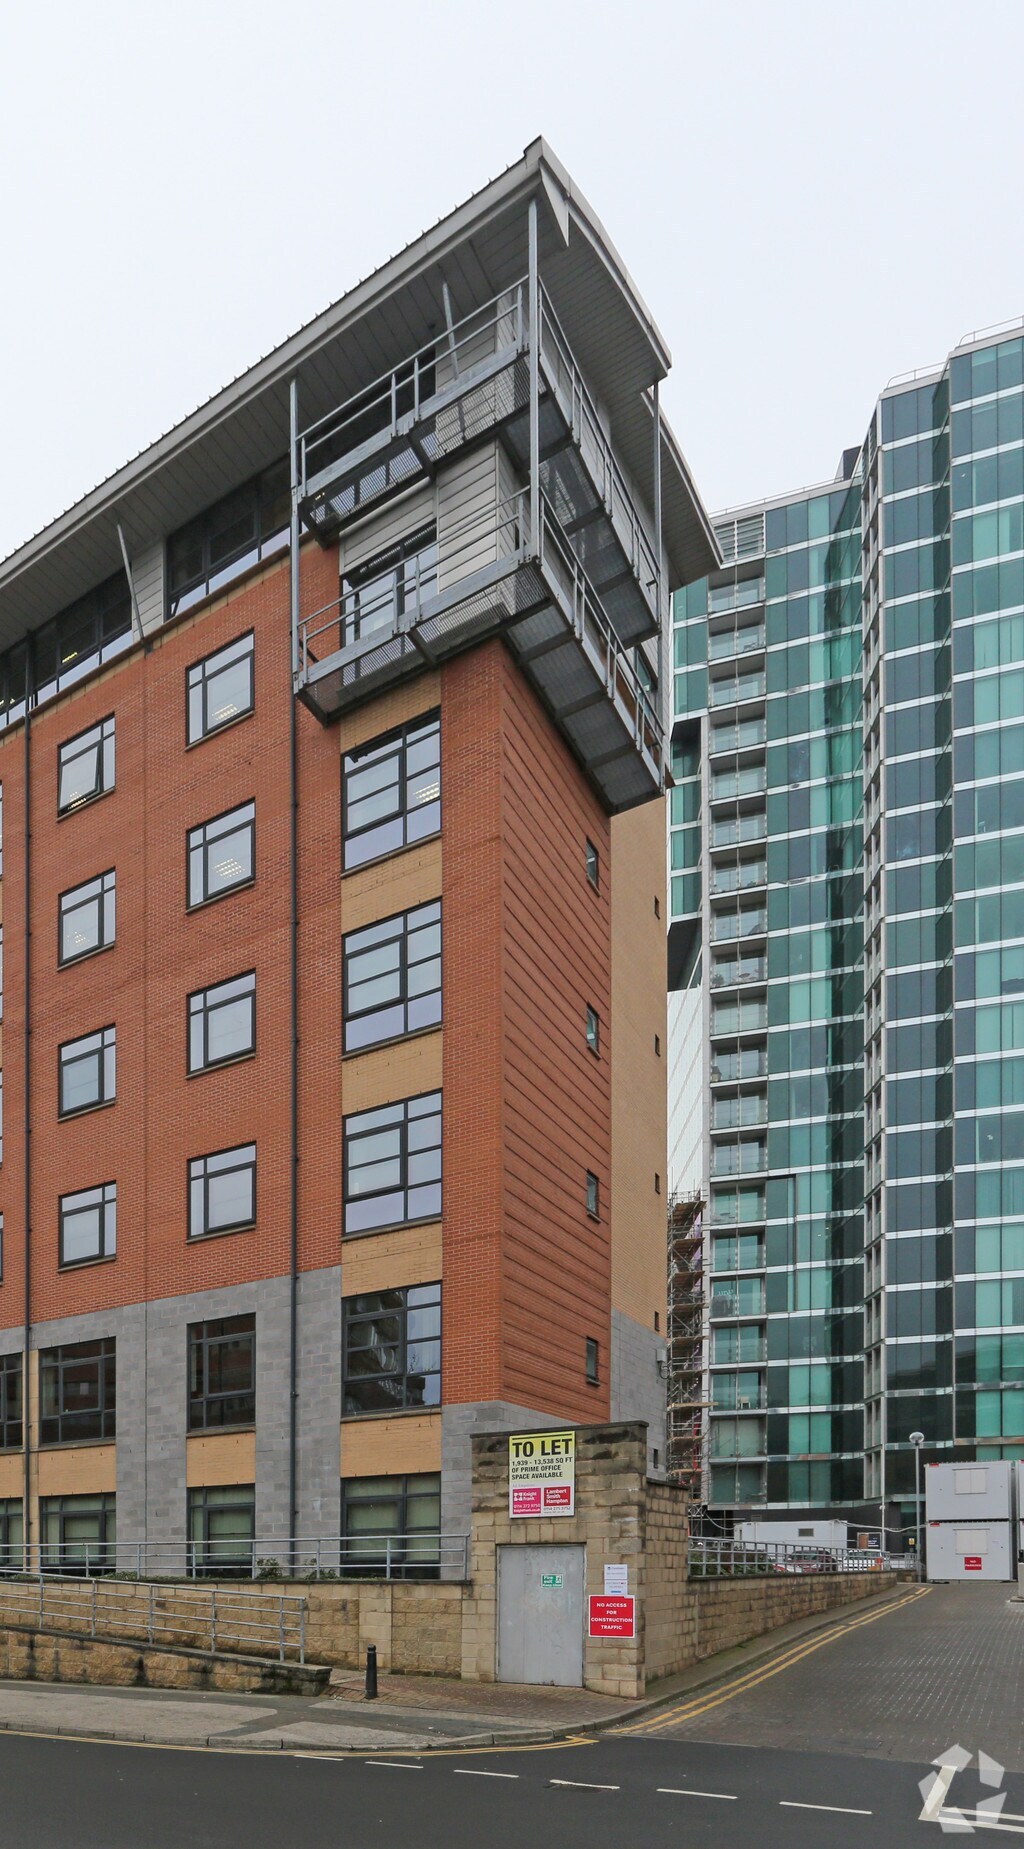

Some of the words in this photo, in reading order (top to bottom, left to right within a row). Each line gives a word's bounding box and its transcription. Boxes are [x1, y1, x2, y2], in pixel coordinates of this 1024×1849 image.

[512, 1441, 534, 1458] TO
[541, 1438, 572, 1456] LET
[531, 1471, 563, 1479] AVAILABLE
